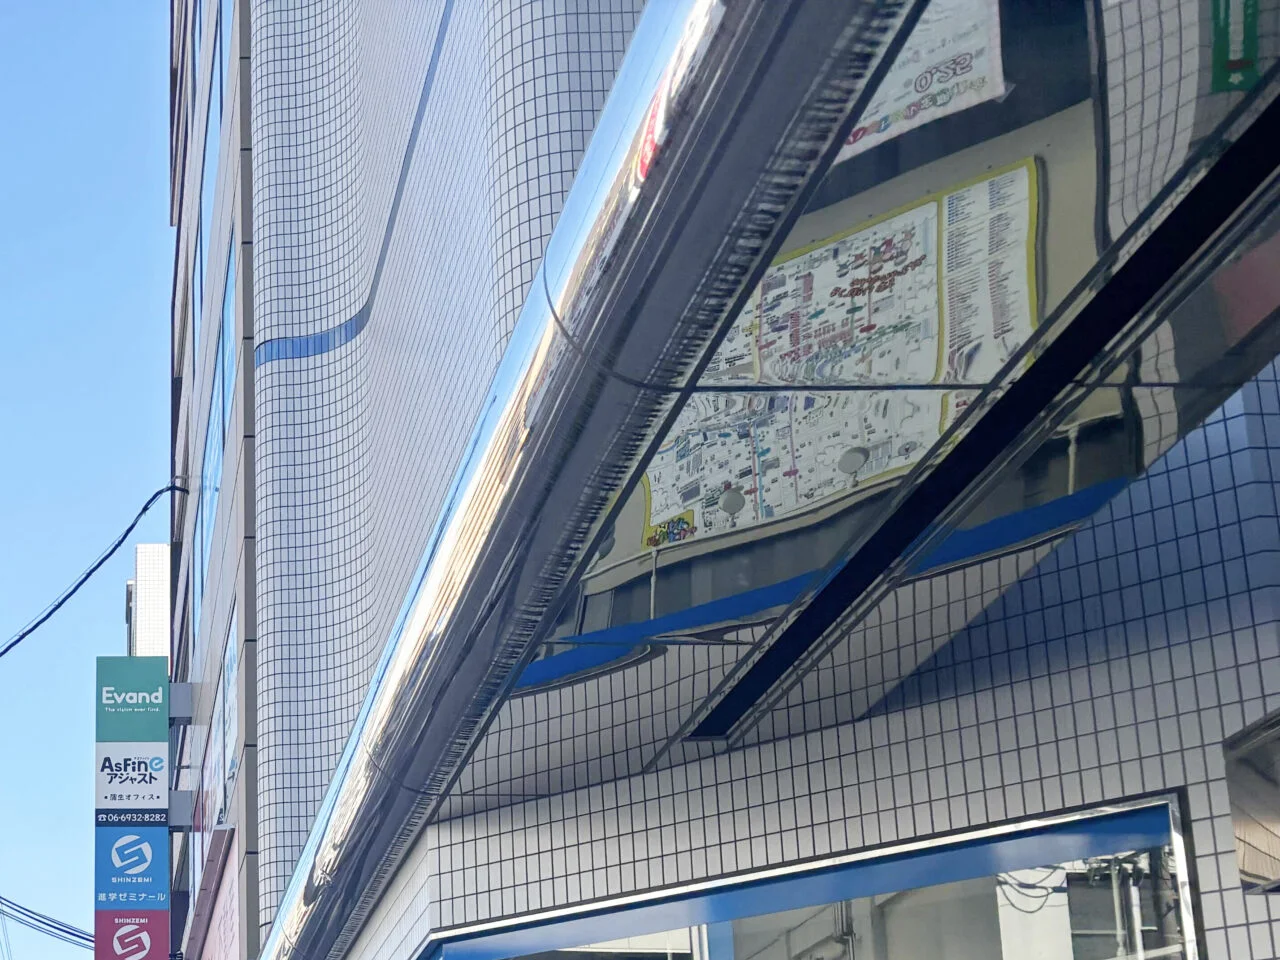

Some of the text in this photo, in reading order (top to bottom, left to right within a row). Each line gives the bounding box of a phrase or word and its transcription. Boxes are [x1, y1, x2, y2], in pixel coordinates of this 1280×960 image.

[102, 687, 163, 704] Evand
[100, 756, 165, 773] AsFine
[106, 773, 158, 785] アジャスト
[98, 892, 166, 902] 進学ゼミナール
